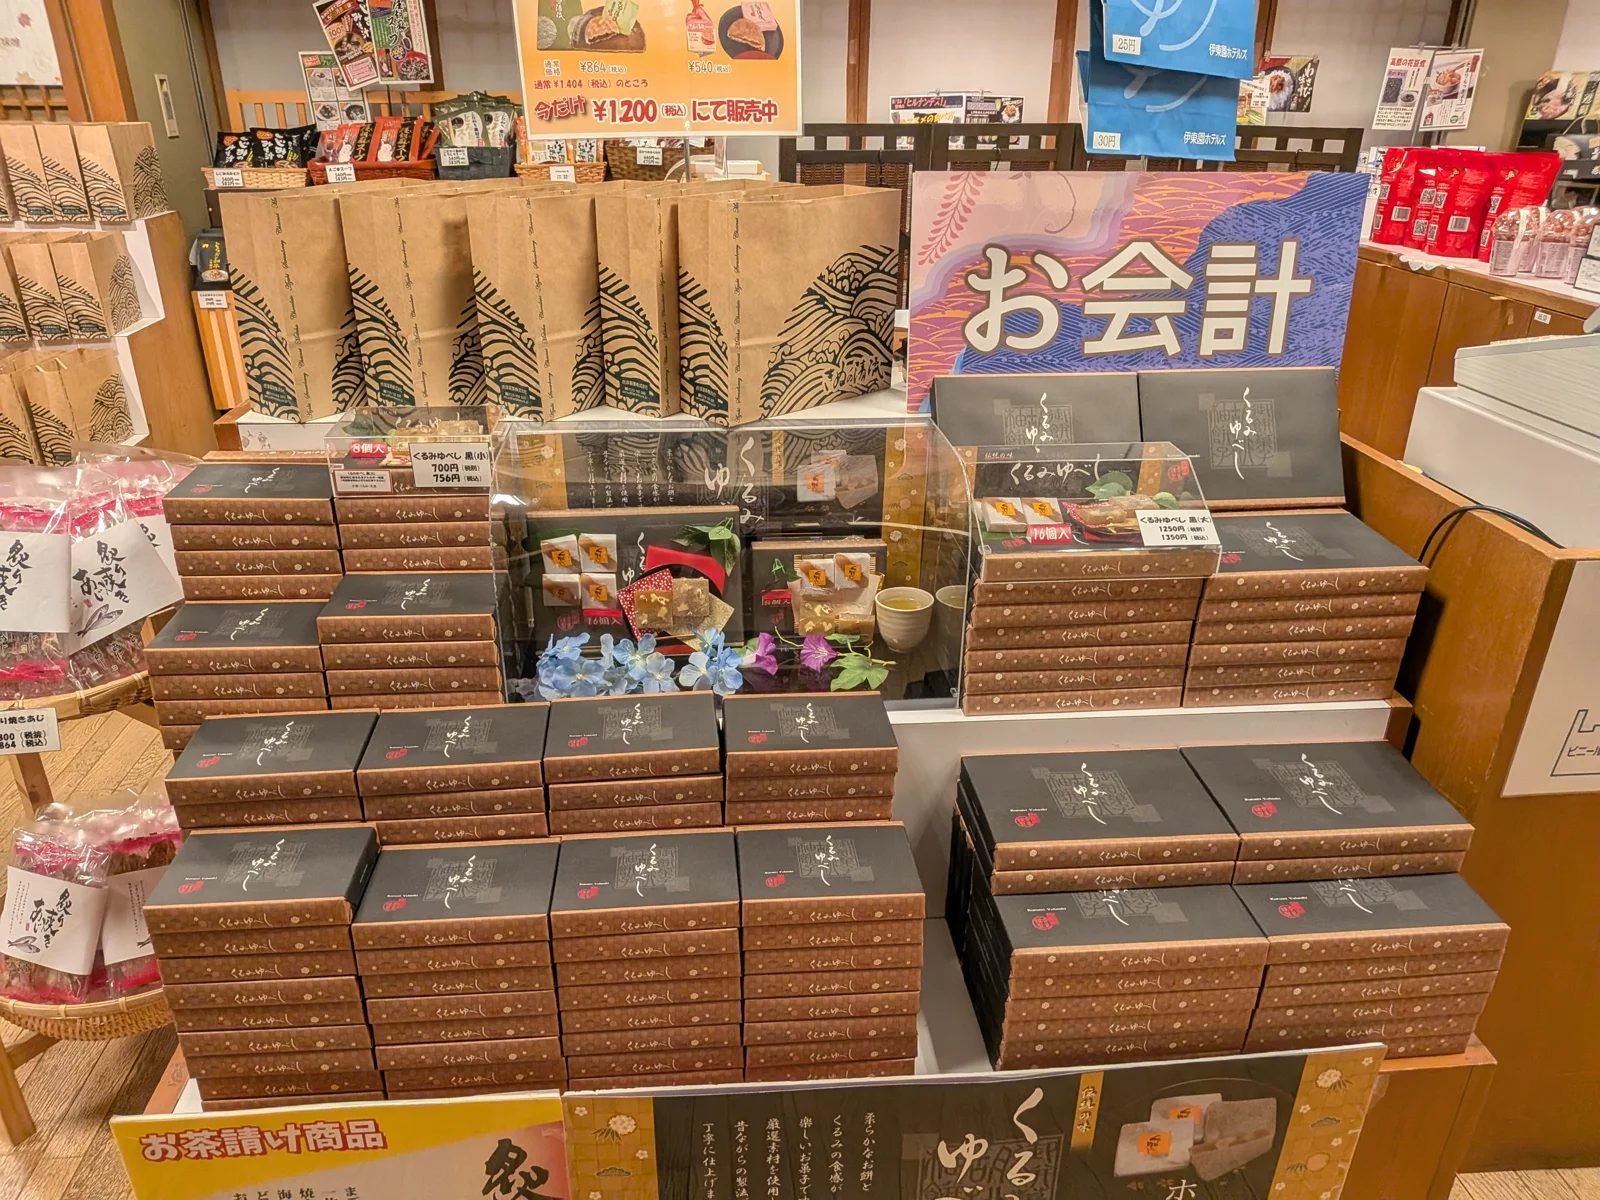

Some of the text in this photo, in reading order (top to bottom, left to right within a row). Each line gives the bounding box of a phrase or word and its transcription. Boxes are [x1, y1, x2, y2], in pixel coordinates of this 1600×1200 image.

[1118, 38, 1136, 52] 25円
[1209, 43, 1247, 60] 伊東園ホテルズ
[580, 61, 606, 73] ¥864
[688, 61, 713, 73] ¥540
[534, 95, 586, 120] 今だけ
[692, 100, 779, 122] にて販売中
[1098, 135, 1116, 148] 30円
[1183, 131, 1226, 146] 伊東園ホテルズ
[964, 240, 1313, 357] お会計
[352, 442, 385, 454] 8個入
[413, 451, 462, 461] くるみゆべし
[431, 463, 459, 472] 700円
[1011, 453, 1100, 485] くるみゆべし
[433, 473, 460, 483] 756円
[1140, 516, 1186, 524] くるみゆべし
[1034, 527, 1070, 540] 16個入
[141, 1117, 388, 1162] お茶請け商品
[1006, 1087, 1044, 1200] くる
[766, 1118, 781, 1200] 厳選素材を使用
[798, 1116, 813, 1200] 楽しいお菓子で
[829, 1114, 844, 1193] くるみの食感が
[859, 1112, 876, 1191] 柔らかなお餅と
[734, 1120, 749, 1200] 昔ながらの製法
